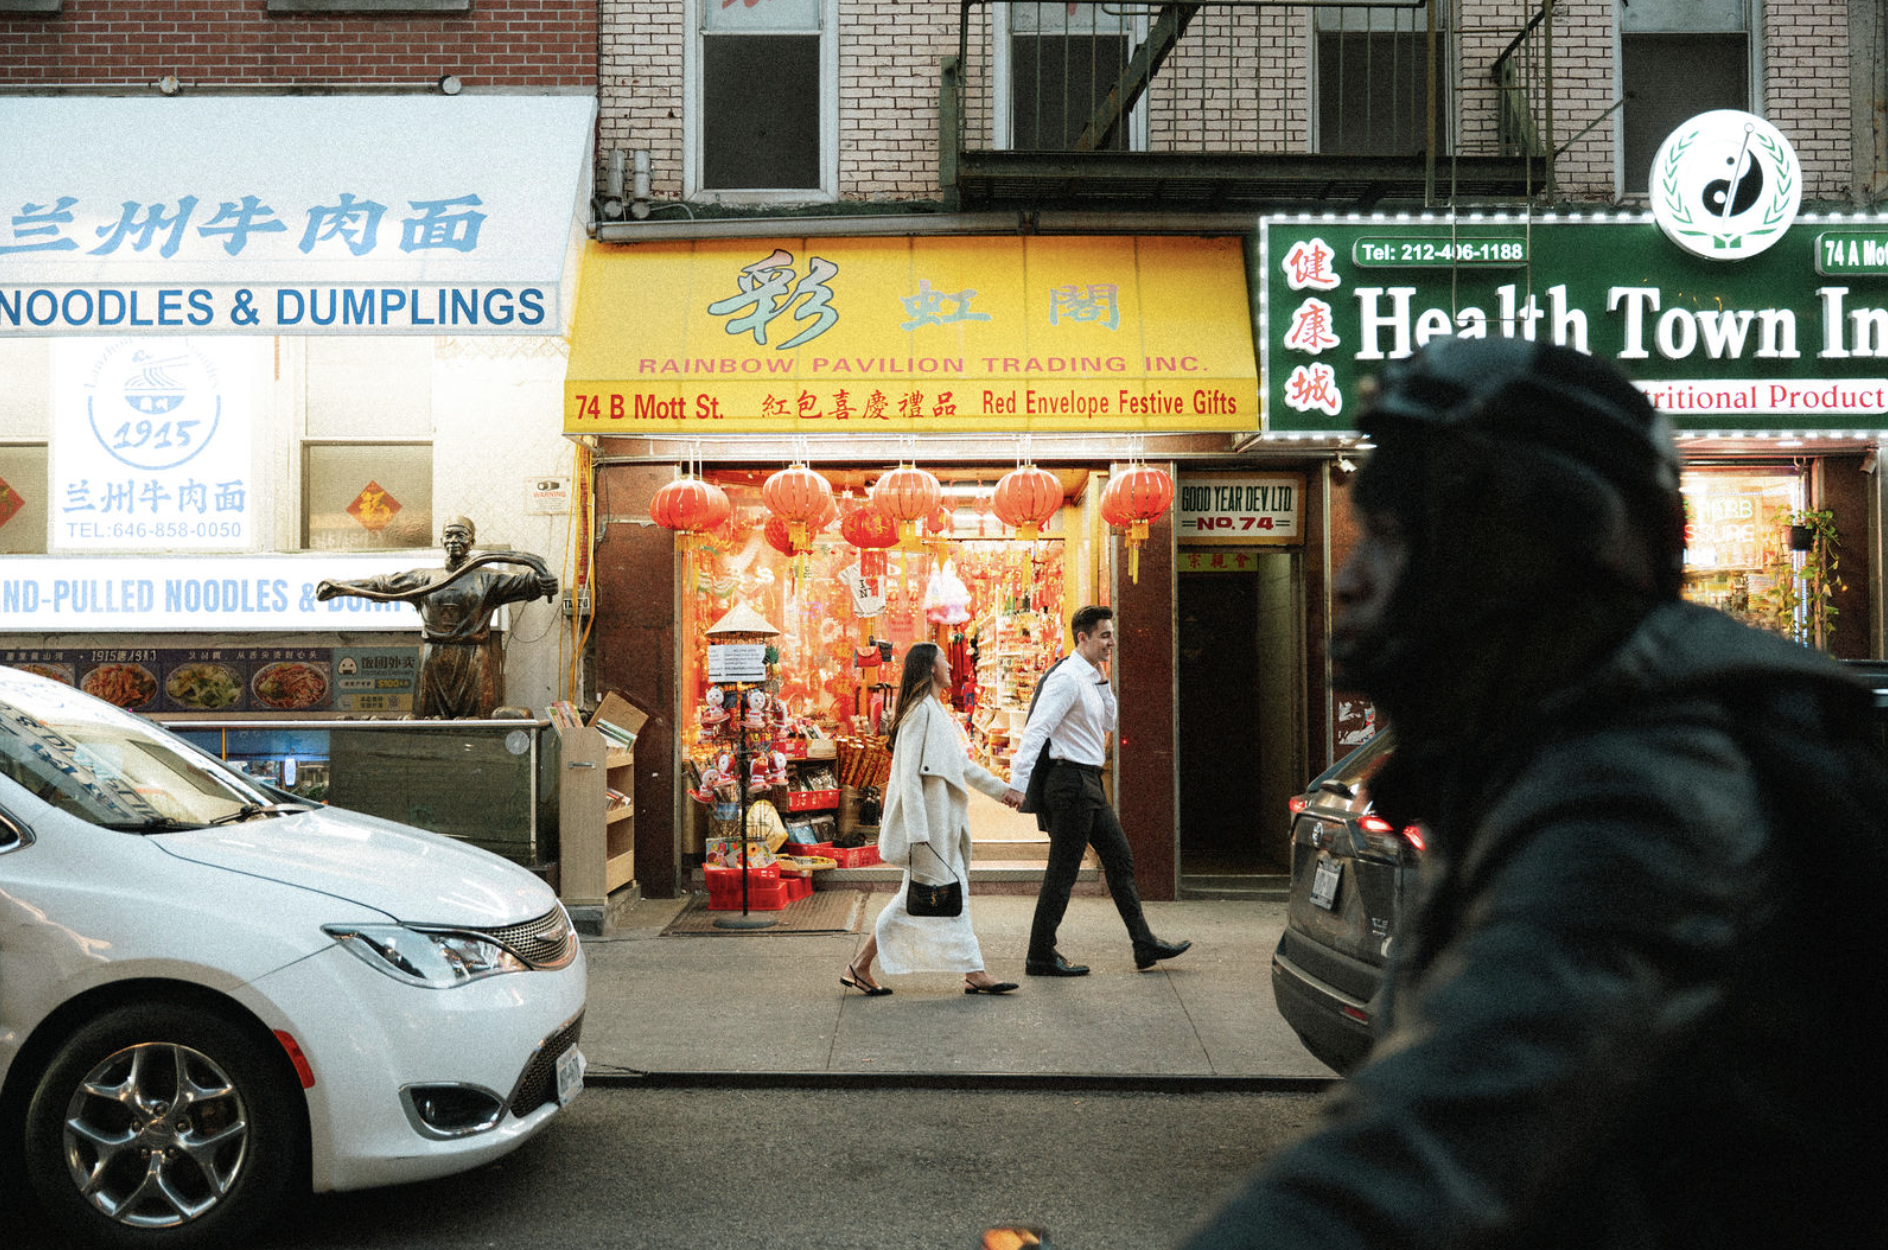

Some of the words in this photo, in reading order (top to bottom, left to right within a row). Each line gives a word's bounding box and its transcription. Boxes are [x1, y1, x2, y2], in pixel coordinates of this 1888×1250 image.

[0, 193, 487, 259] 兰州牛肉面
[1362, 244, 1396, 261] Tel:
[1401, 243, 1523, 261] 212-406-1188
[1825, 240, 1845, 267] 74
[1848, 240, 1860, 267] A
[0, 288, 214, 326] NOODLES
[230, 288, 261, 326] &
[276, 287, 546, 326] DUMPLINGS
[1290, 244, 1336, 409] 健康城
[1353, 283, 1592, 361] Health
[1606, 286, 1800, 360] Town
[638, 357, 795, 374] RAINBOW
[811, 356, 964, 374] PAVILION
[982, 356, 1127, 373] TRADING
[1145, 356, 1209, 372] INC.
[575, 394, 601, 420] 74
[610, 394, 625, 420] B
[633, 393, 687, 420] Mott
[695, 393, 724, 420] St.
[761, 388, 957, 421] 紅包喜慶禮品
[982, 389, 1017, 415] Red
[1026, 389, 1109, 419] Envelope
[1119, 389, 1184, 415] Festive
[1192, 389, 1237, 415] Gifts
[1643, 385, 1758, 409] ritional
[1768, 384, 1885, 409] Product
[112, 418, 201, 450] 1915
[63, 477, 247, 516] 兰州牛肉面
[1181, 485, 1211, 512] GOOD
[1214, 485, 1243, 512] YEAR
[65, 521, 242, 539] TEL:646-858-0050
[1197, 516, 1236, 531] NO.
[1239, 516, 1274, 531] 74
[1177, 553, 1251, 569] 宗親會
[0, 579, 154, 613] ND-PULLED
[165, 579, 288, 614] NOODLES
[298, 582, 317, 612] &
